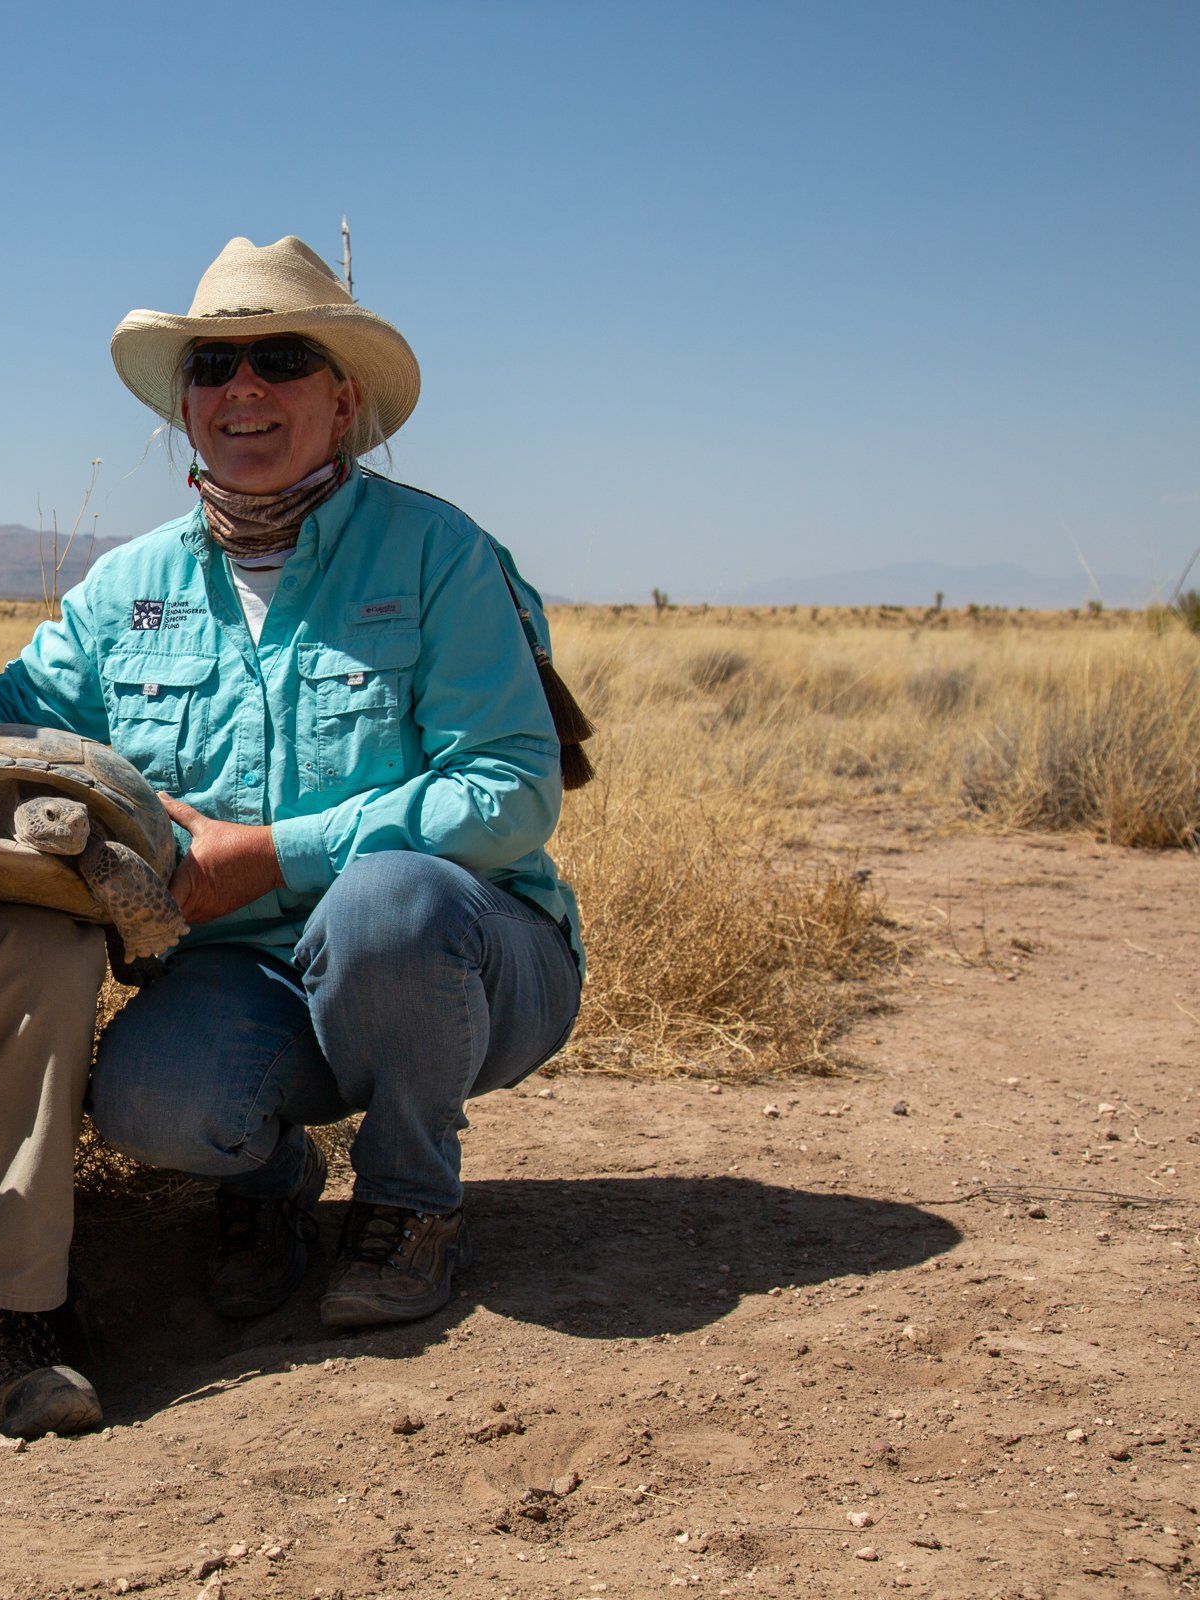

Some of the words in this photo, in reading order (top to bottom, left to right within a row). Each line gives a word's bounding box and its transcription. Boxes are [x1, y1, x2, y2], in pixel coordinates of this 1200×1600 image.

[167, 601, 189, 609] TURNER
[165, 608, 207, 616] ENDANGERED
[164, 615, 188, 624] SPECIES
